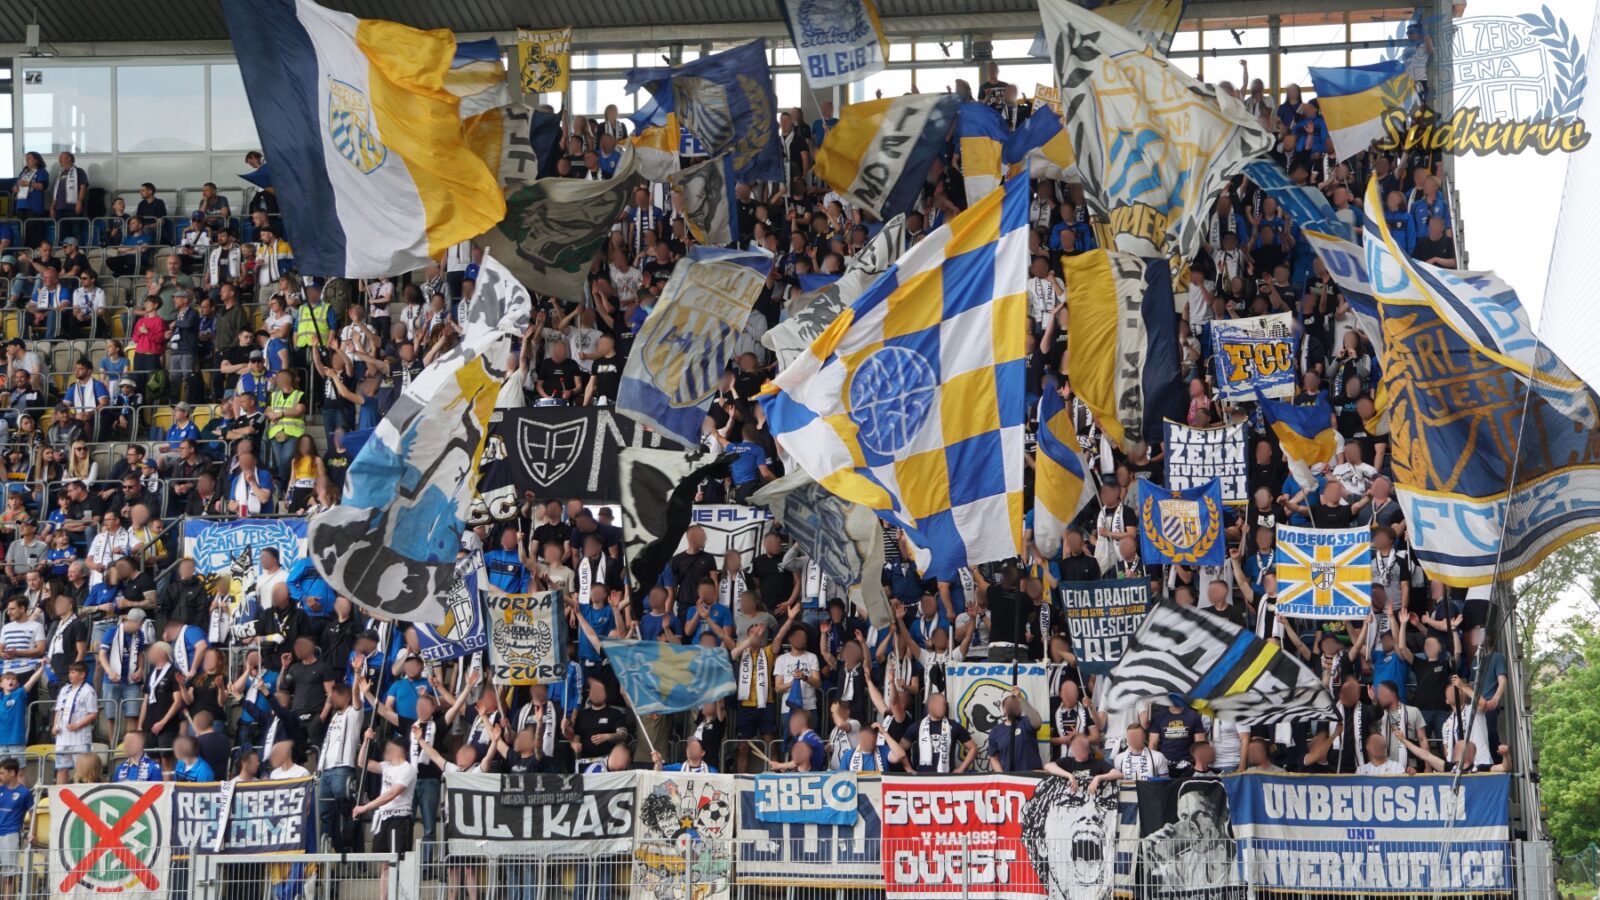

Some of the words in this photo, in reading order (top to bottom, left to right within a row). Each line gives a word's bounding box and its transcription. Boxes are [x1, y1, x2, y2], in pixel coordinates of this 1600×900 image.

[808, 40, 876, 78] BLEIBT
[1223, 342, 1292, 382] FCC
[1170, 423, 1244, 444] NEUN
[1170, 442, 1245, 465] ZEHN
[1170, 463, 1246, 477] HUNDERT
[1277, 530, 1370, 546] UNBEUGSAM
[486, 593, 552, 611] HORDA
[1094, 585, 1148, 608] BRANCO
[421, 643, 455, 661] SEIT
[947, 665, 1046, 677] HORDA
[178, 786, 306, 820] REFUGEES
[758, 773, 857, 812] 3850
[1262, 783, 1466, 821] UNBEUGSAM
[885, 789, 1028, 825] SECTION
[177, 815, 302, 848] WECOME
[1346, 828, 1376, 841] UND
[894, 849, 1017, 885] OUEST
